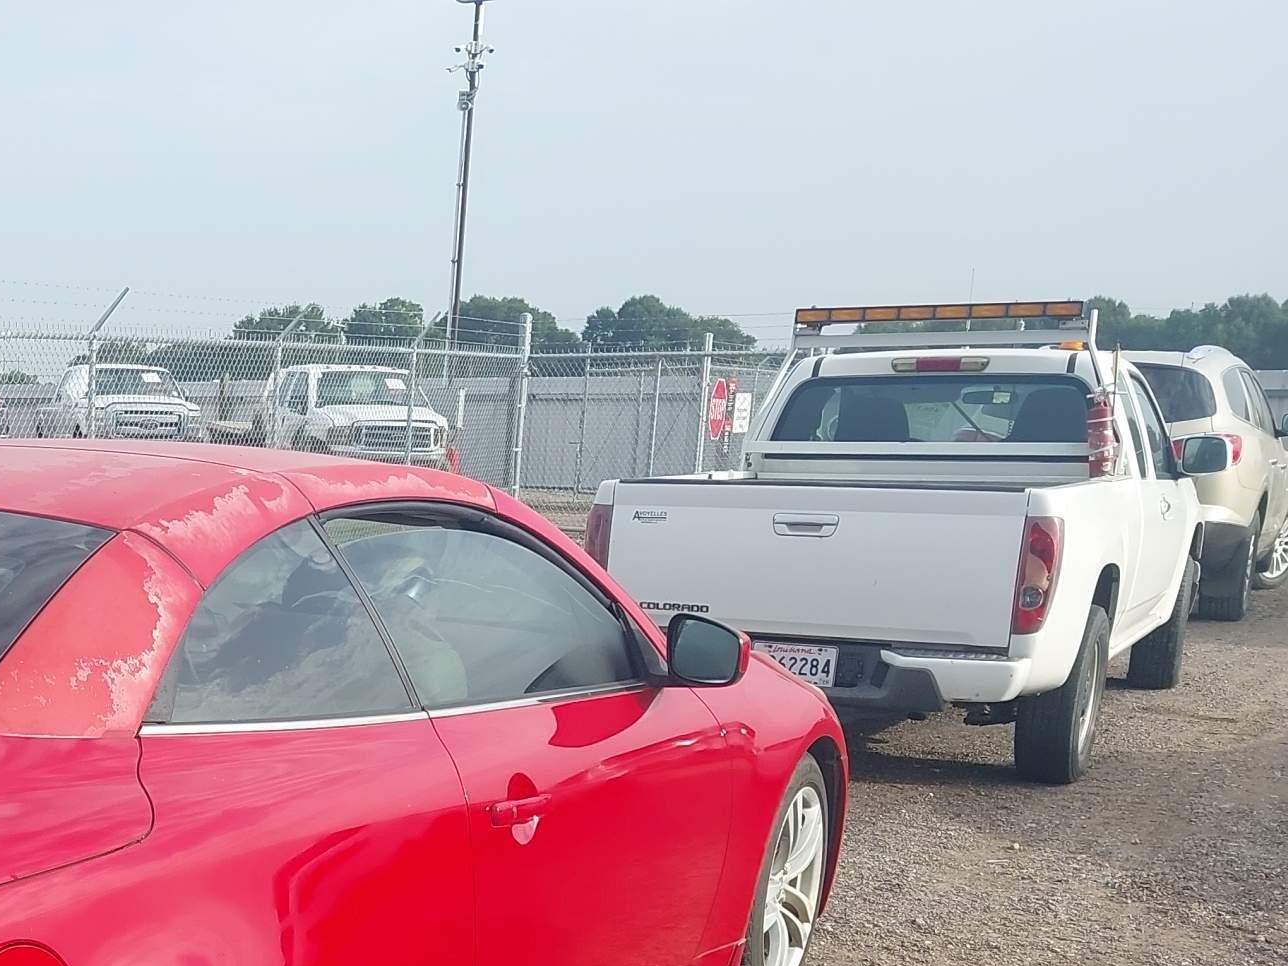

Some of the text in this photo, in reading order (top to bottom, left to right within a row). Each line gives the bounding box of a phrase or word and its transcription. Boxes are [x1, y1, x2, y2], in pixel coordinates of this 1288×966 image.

[710, 398, 726, 421] STOP
[639, 601, 710, 613] COLORADO
[769, 654, 831, 678] 62284
